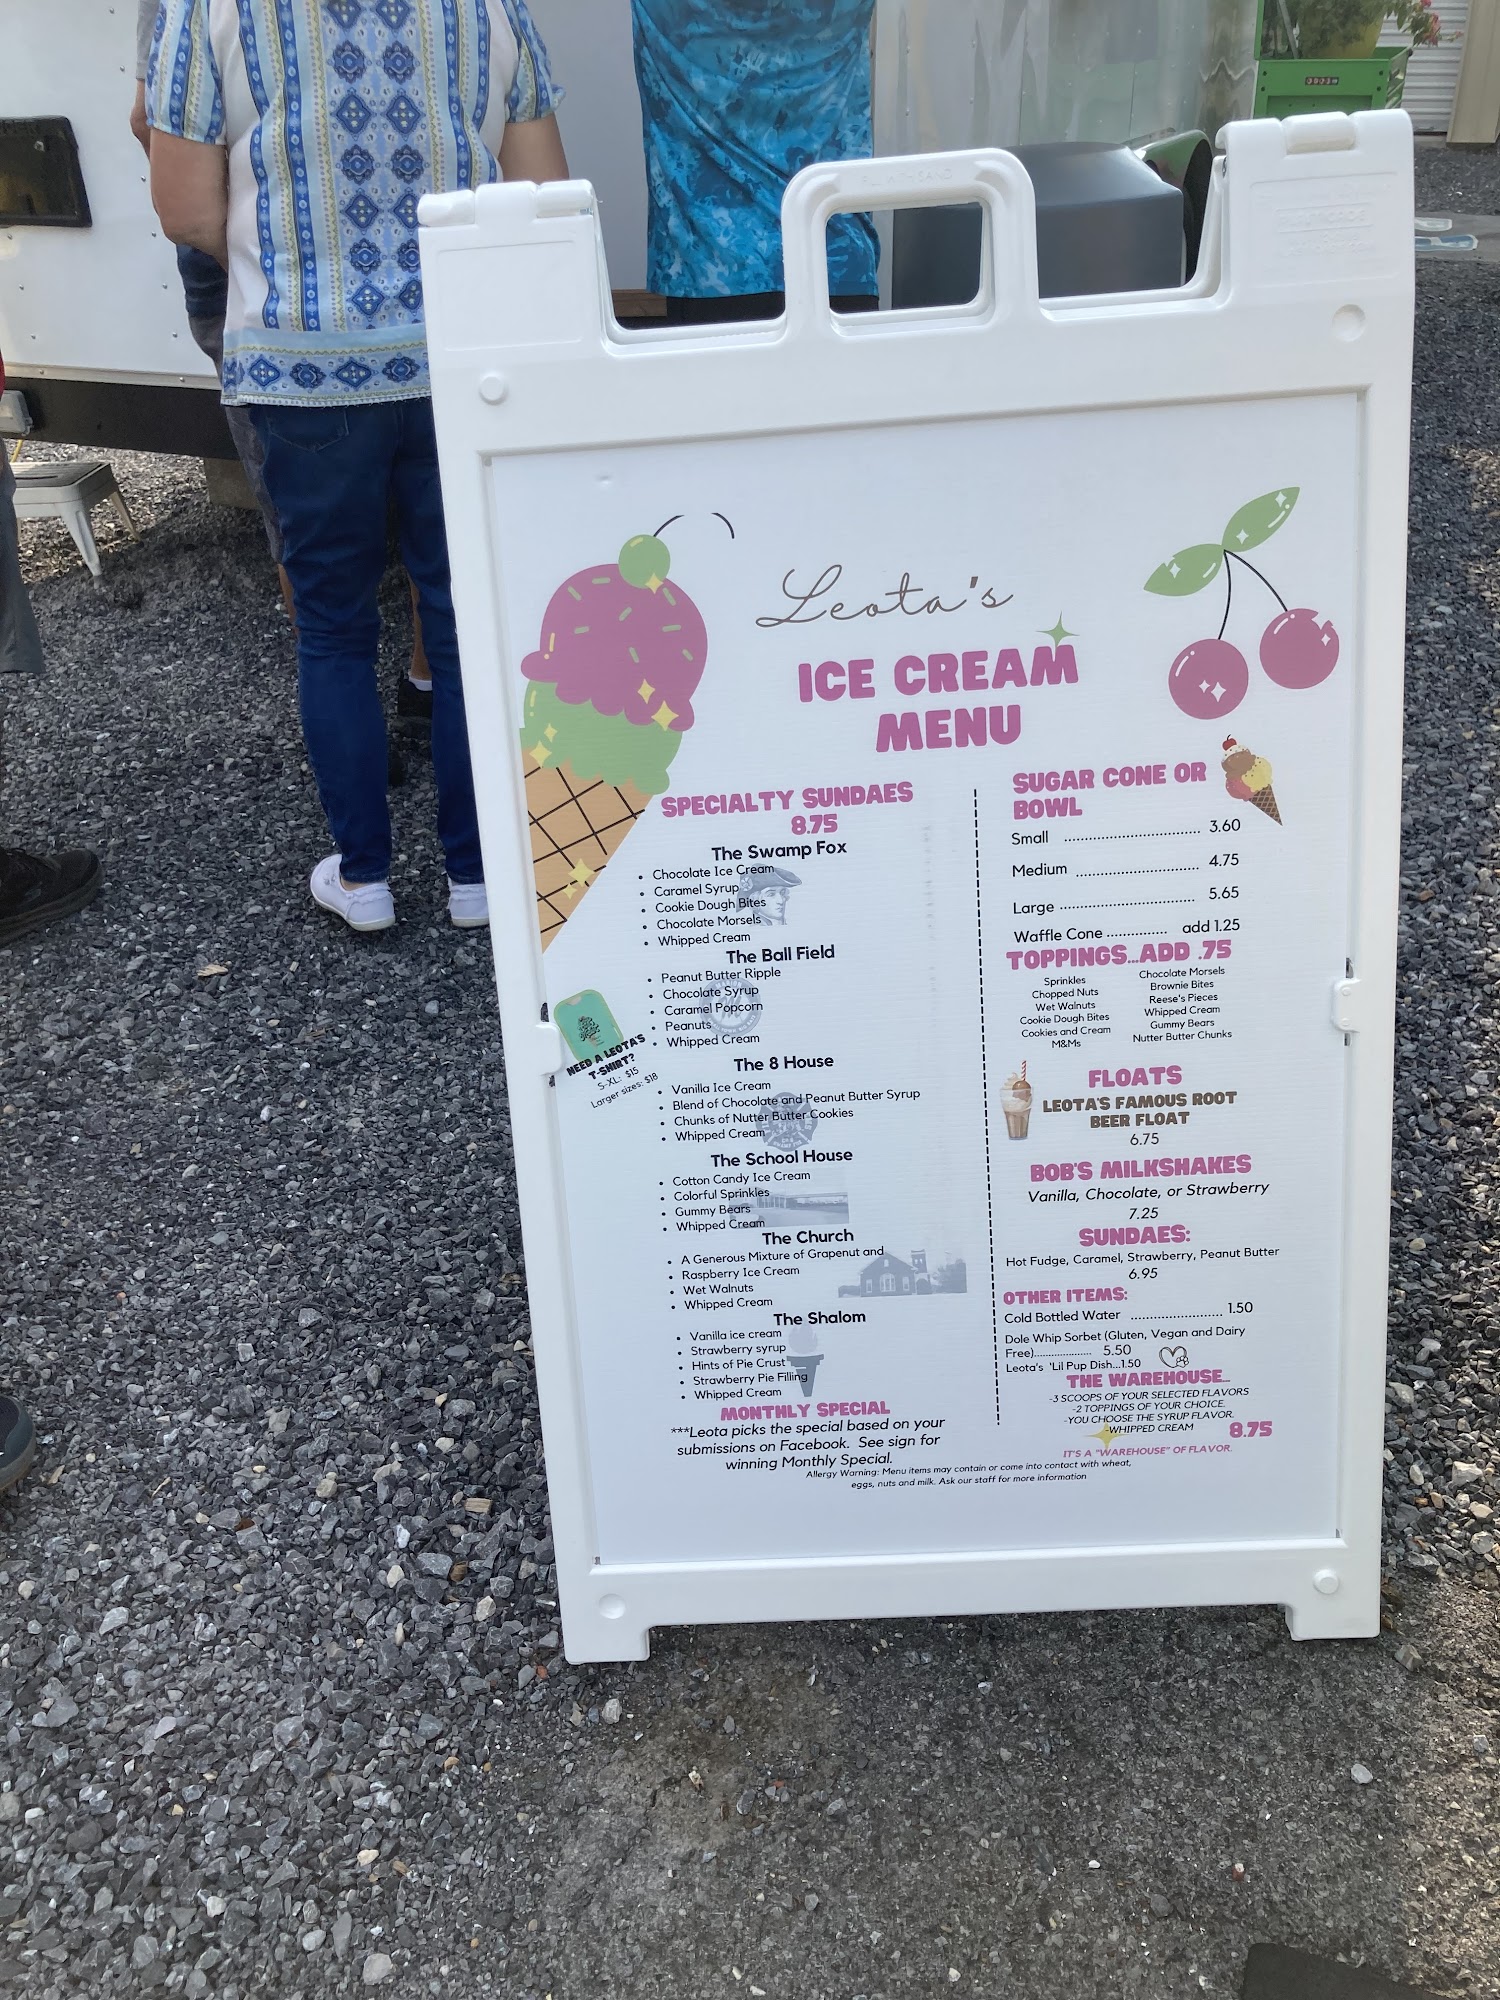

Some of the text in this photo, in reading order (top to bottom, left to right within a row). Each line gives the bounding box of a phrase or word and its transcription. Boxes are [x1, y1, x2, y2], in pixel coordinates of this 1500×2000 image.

[755, 564, 1014, 628] Leota's
[798, 644, 1079, 703] ICE CREAM
[876, 704, 1021, 753] MENU
[1013, 762, 1207, 794] SUGAR CONE OR
[661, 781, 913, 818] SPECIALTY SUNDAES
[1013, 797, 1083, 820] BOWL
[791, 813, 838, 835] 8.75
[1011, 818, 1241, 845] Small 3.60
[711, 840, 847, 861] The Swamp Fox
[653, 864, 775, 880] Chocolate Ice Cream
[1012, 853, 1239, 877] Medium 4.75
[1013, 886, 1239, 916] Large 5.65
[658, 932, 751, 947] Whipped Cream
[1014, 918, 1240, 943] Waffle Cone add 1.25
[726, 944, 835, 964] The Ball Field
[1044, 976, 1086, 988] Sprinkles
[1139, 966, 1225, 979] Chocolate Morsels
[1032, 988, 1099, 1000] Chopped Nuts
[1149, 993, 1218, 1004] Reese's Pieces
[1052, 1039, 1081, 1048] M&Ms
[566, 1033, 646, 1077] NEED A LEOTA'S
[733, 1055, 834, 1072] The 8 House
[588, 1053, 635, 1080] T-SHIRT?
[1089, 1065, 1182, 1088] FLOATS
[597, 1066, 640, 1091] S-XL: $15
[590, 1072, 659, 1109] Larger sizes: $18
[1043, 1091, 1237, 1113] LEOTA'S FAMOUS ROOT
[1090, 1111, 1190, 1128] BEER FLOAT
[1130, 1132, 1159, 1146] 6.75
[710, 1149, 853, 1167] The School House
[1030, 1154, 1252, 1182] BOB'S MILKSHAKES
[672, 1171, 811, 1186] Cotton Candy Ice Cream
[1028, 1182, 1270, 1203] Vanilla, Chocolate, or Strawberry
[1129, 1207, 1158, 1220] 7.25
[762, 1228, 854, 1245] The Church
[1079, 1224, 1191, 1247] SUNDAES:
[681, 1245, 884, 1265] A Generous Mixture of Grapenut and
[1006, 1247, 1280, 1267] Hot Fudge, Caramel, Strawberry, Peanut Butter
[1128, 1267, 1158, 1280] 6.95
[1003, 1287, 1128, 1305] OTHER ITEMS:
[773, 1310, 866, 1326] The Shalom
[1004, 1301, 1253, 1324] Cold Bottled Water 1.50
[1005, 1326, 1246, 1345] Dole Whip Sorbet (Gluten, Vegan and Dairy
[1066, 1374, 1103, 1388] THE
[1061, 1393, 1102, 1403] SCOOPS
[1104, 1392, 1119, 1401] OF
[1121, 1391, 1149, 1400] YOUR
[1151, 1389, 1200, 1399] SELECTED
[1202, 1387, 1249, 1397] FLAVORS
[721, 1401, 890, 1421] MONTHLY SPECIAL
[731, 1423, 766, 1439] picks
[770, 1422, 792, 1435] the
[796, 1420, 843, 1436] special
[847, 1418, 889, 1431] based
[893, 1421, 909, 1429] on
[914, 1419, 946, 1431] your
[1229, 1421, 1272, 1438] 8.75
[677, 1433, 941, 1456] submissions on Facebook. See sign for
[1173, 1446, 1187, 1454] OF
[726, 1452, 892, 1471] winning Monthly Special.
[806, 1470, 838, 1479] Allergy
[840, 1469, 879, 1477] Warning:
[882, 1467, 907, 1475] Menu
[954, 1464, 987, 1473] contain
[1000, 1463, 1024, 1471] come
[1025, 1462, 1042, 1470] into
[1044, 1461, 1078, 1469] contact
[1080, 1459, 1099, 1468] with
[1101, 1459, 1132, 1468] wheat,
